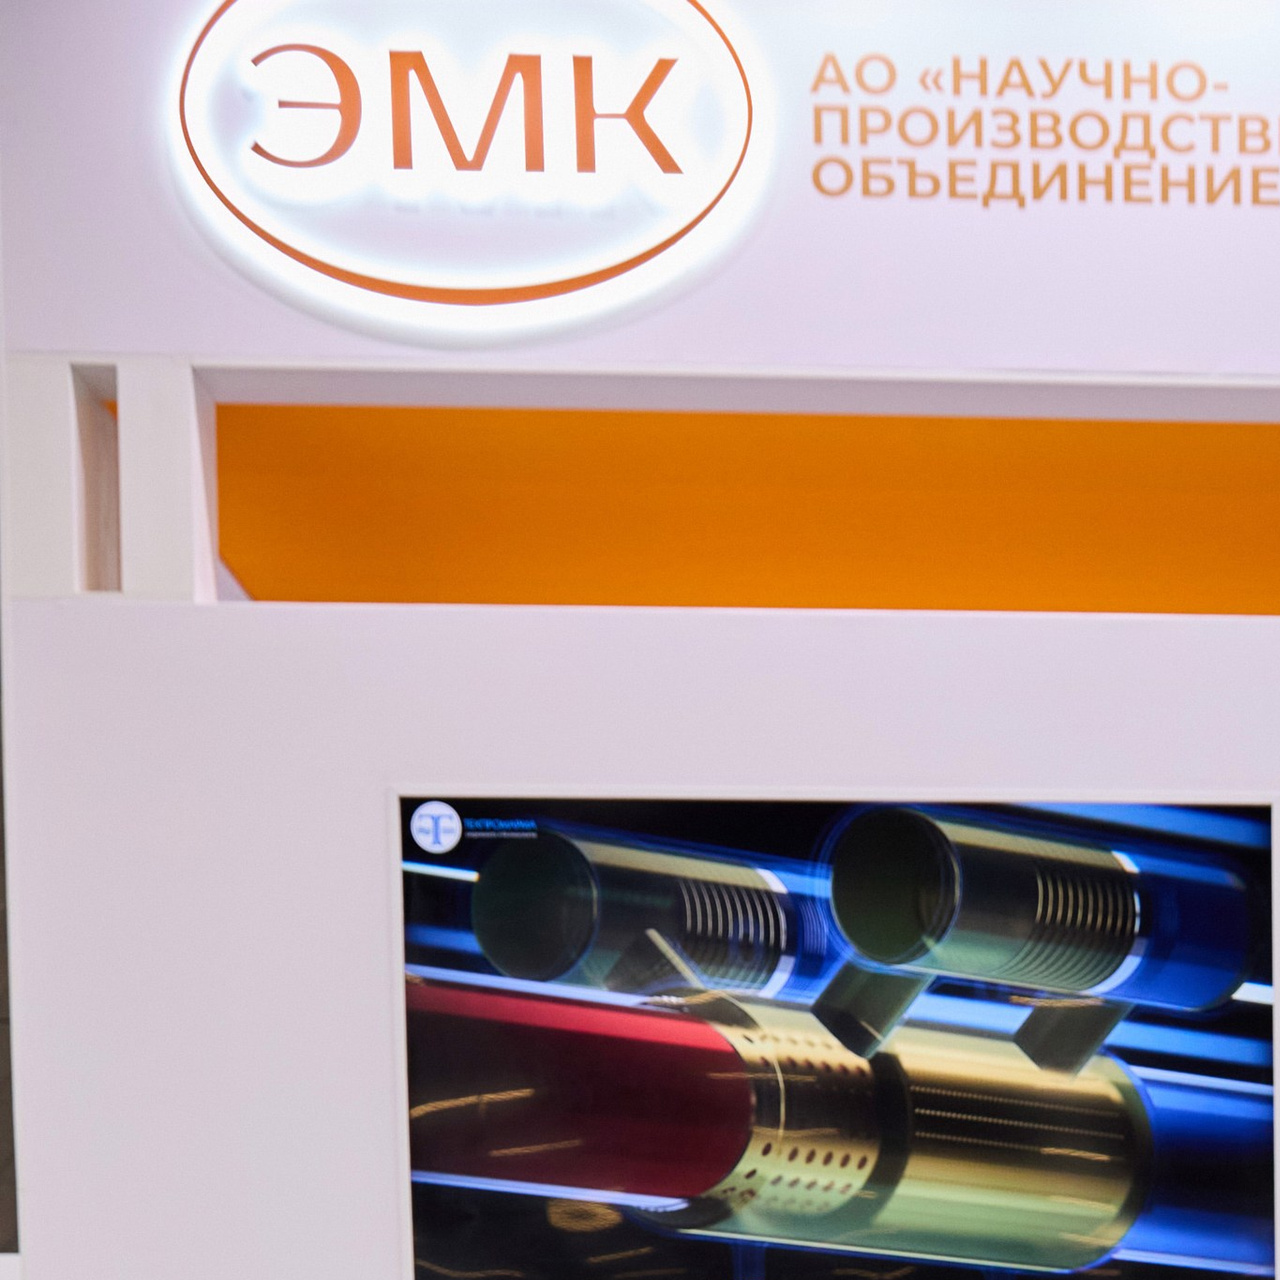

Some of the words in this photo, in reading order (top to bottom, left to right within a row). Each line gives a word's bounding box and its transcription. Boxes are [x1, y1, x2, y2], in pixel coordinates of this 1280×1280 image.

[249, 42, 685, 175] ЭМК
[810, 51, 898, 96] АО
[918, 54, 1230, 103] «НАУЧНО-
